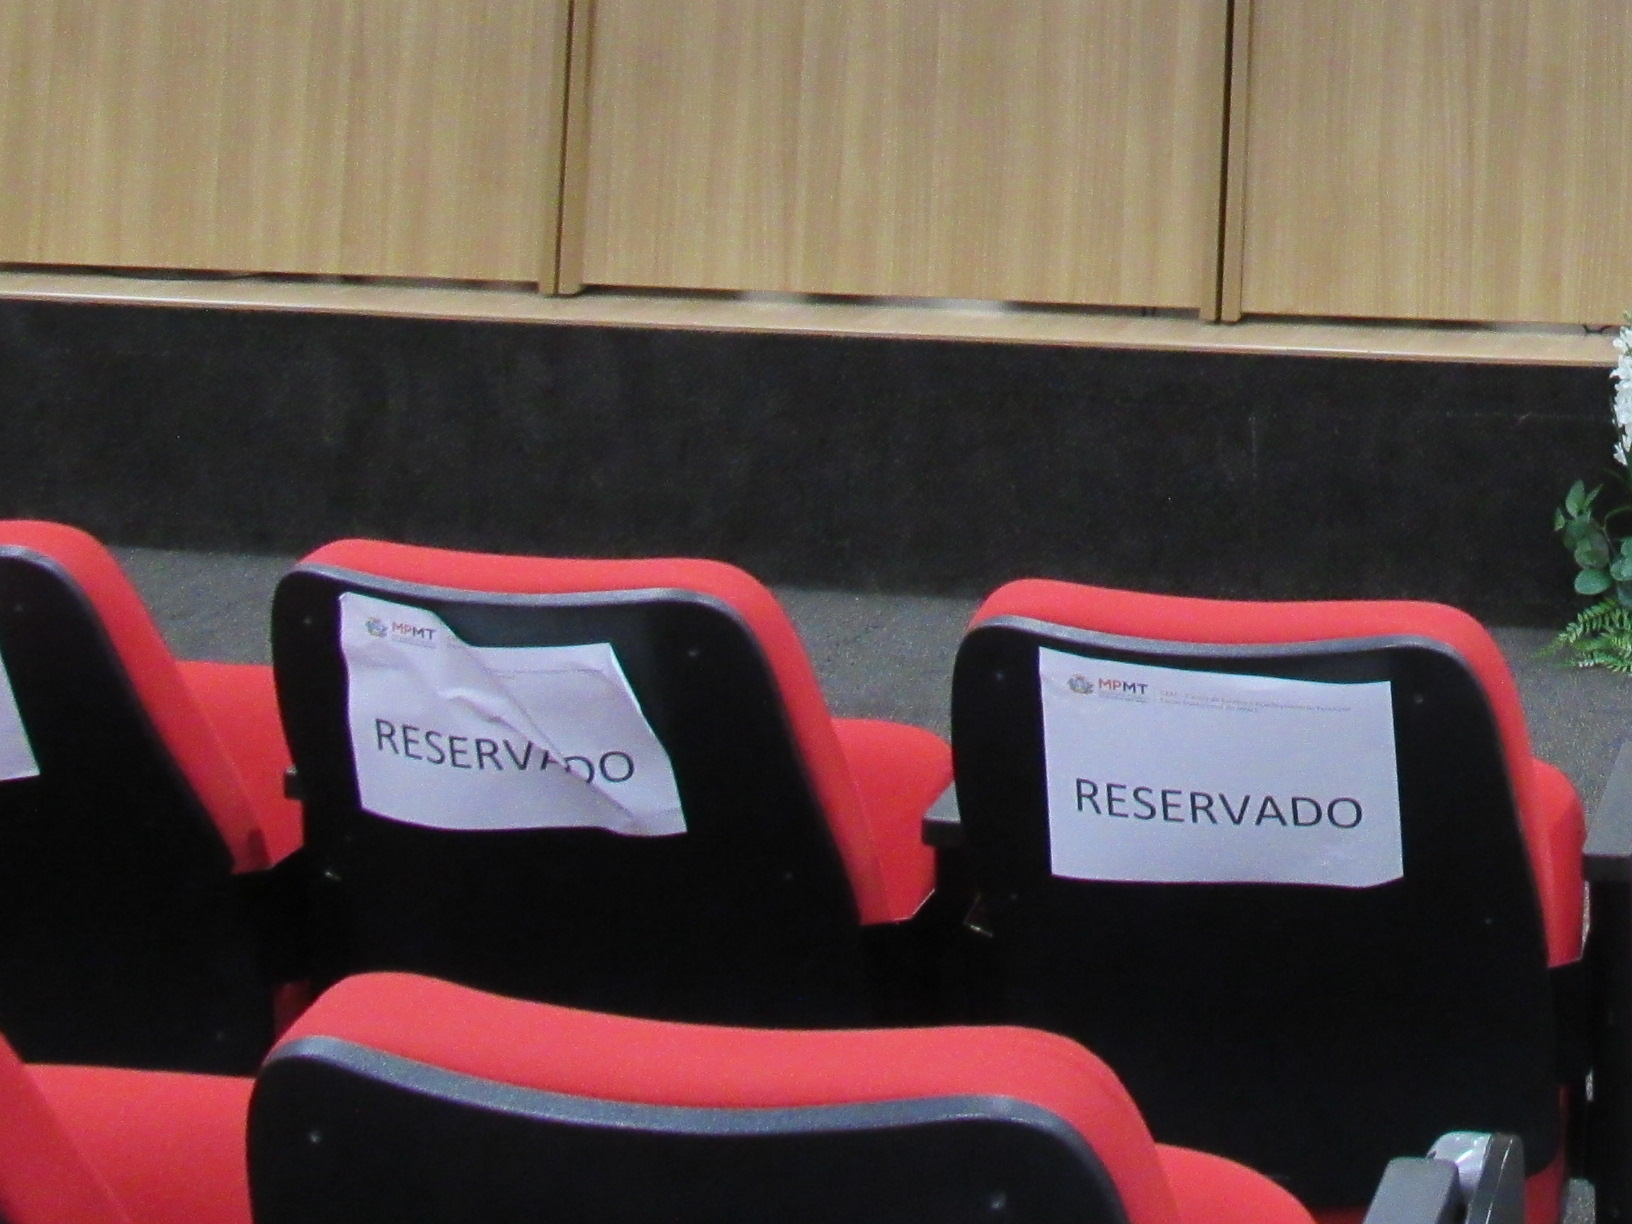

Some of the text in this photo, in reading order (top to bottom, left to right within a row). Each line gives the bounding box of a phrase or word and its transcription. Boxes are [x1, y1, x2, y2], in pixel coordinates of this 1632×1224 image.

[391, 622, 436, 640] MPMT
[1098, 678, 1149, 694] MPMT
[1075, 777, 1364, 830] RESERVADO
